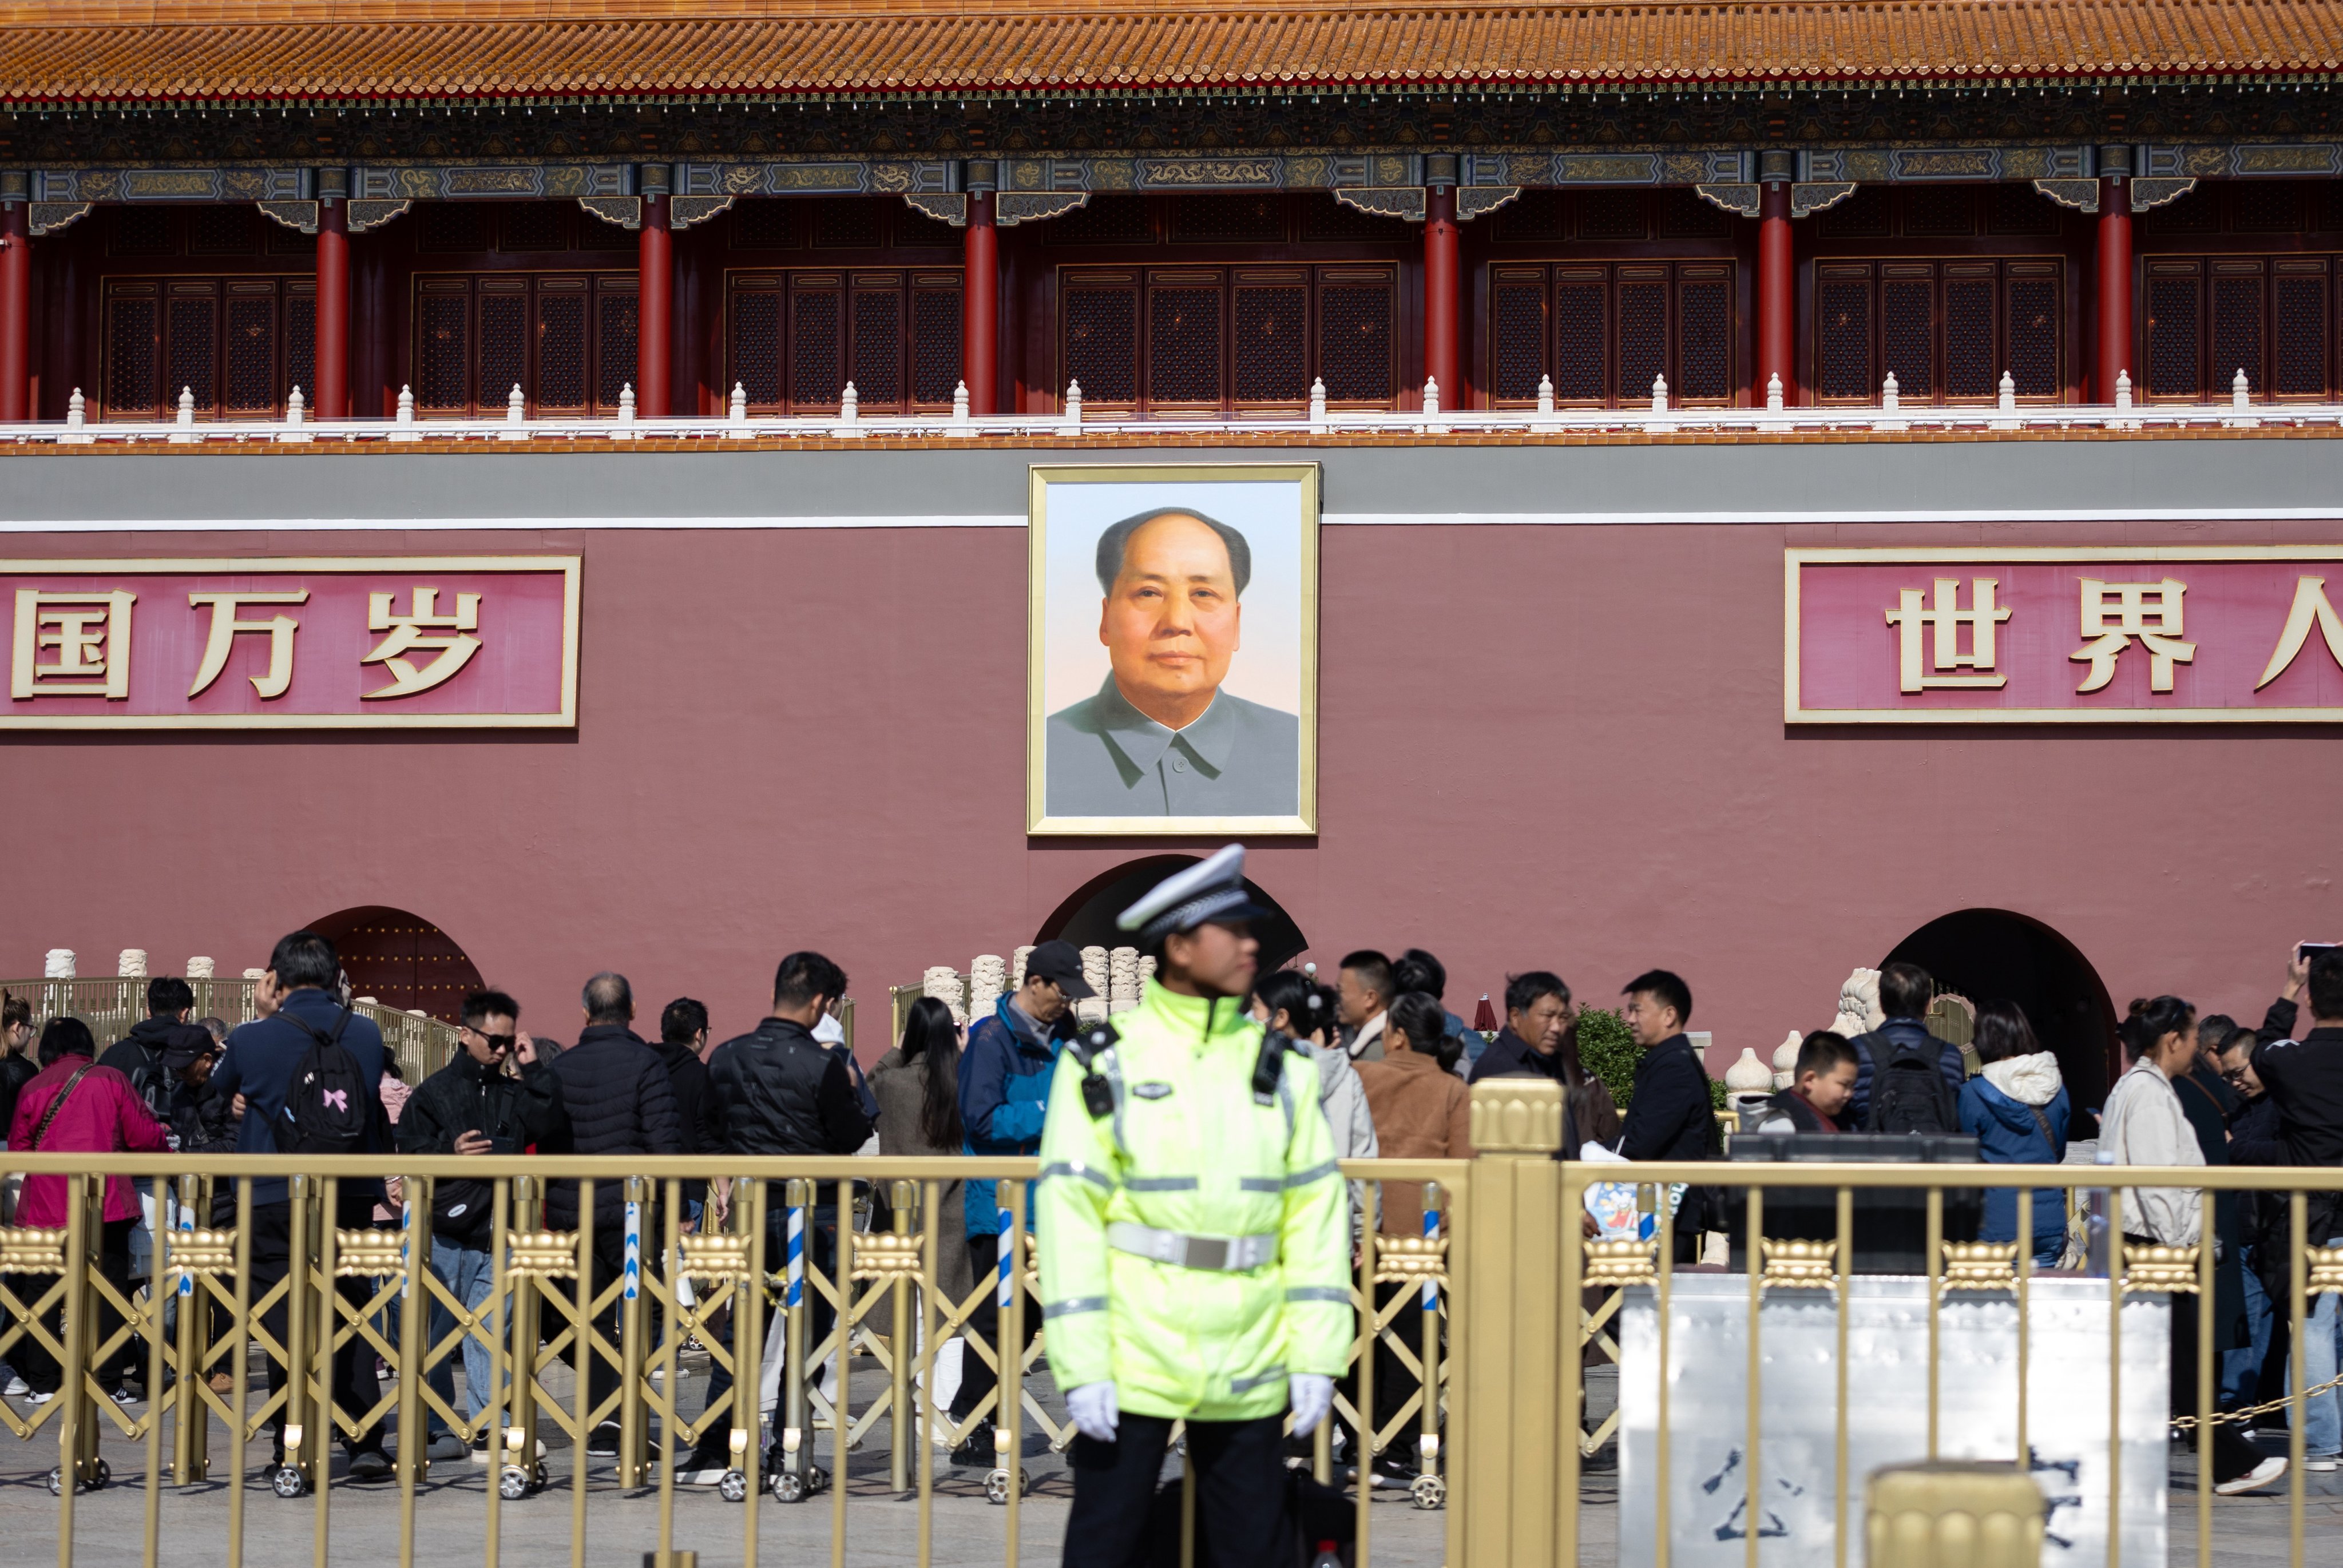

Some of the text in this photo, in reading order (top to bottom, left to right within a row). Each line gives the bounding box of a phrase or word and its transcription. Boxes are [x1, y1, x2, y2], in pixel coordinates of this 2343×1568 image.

[11, 586, 482, 700] 国万岁
[1885, 575, 2343, 692] 世界人
